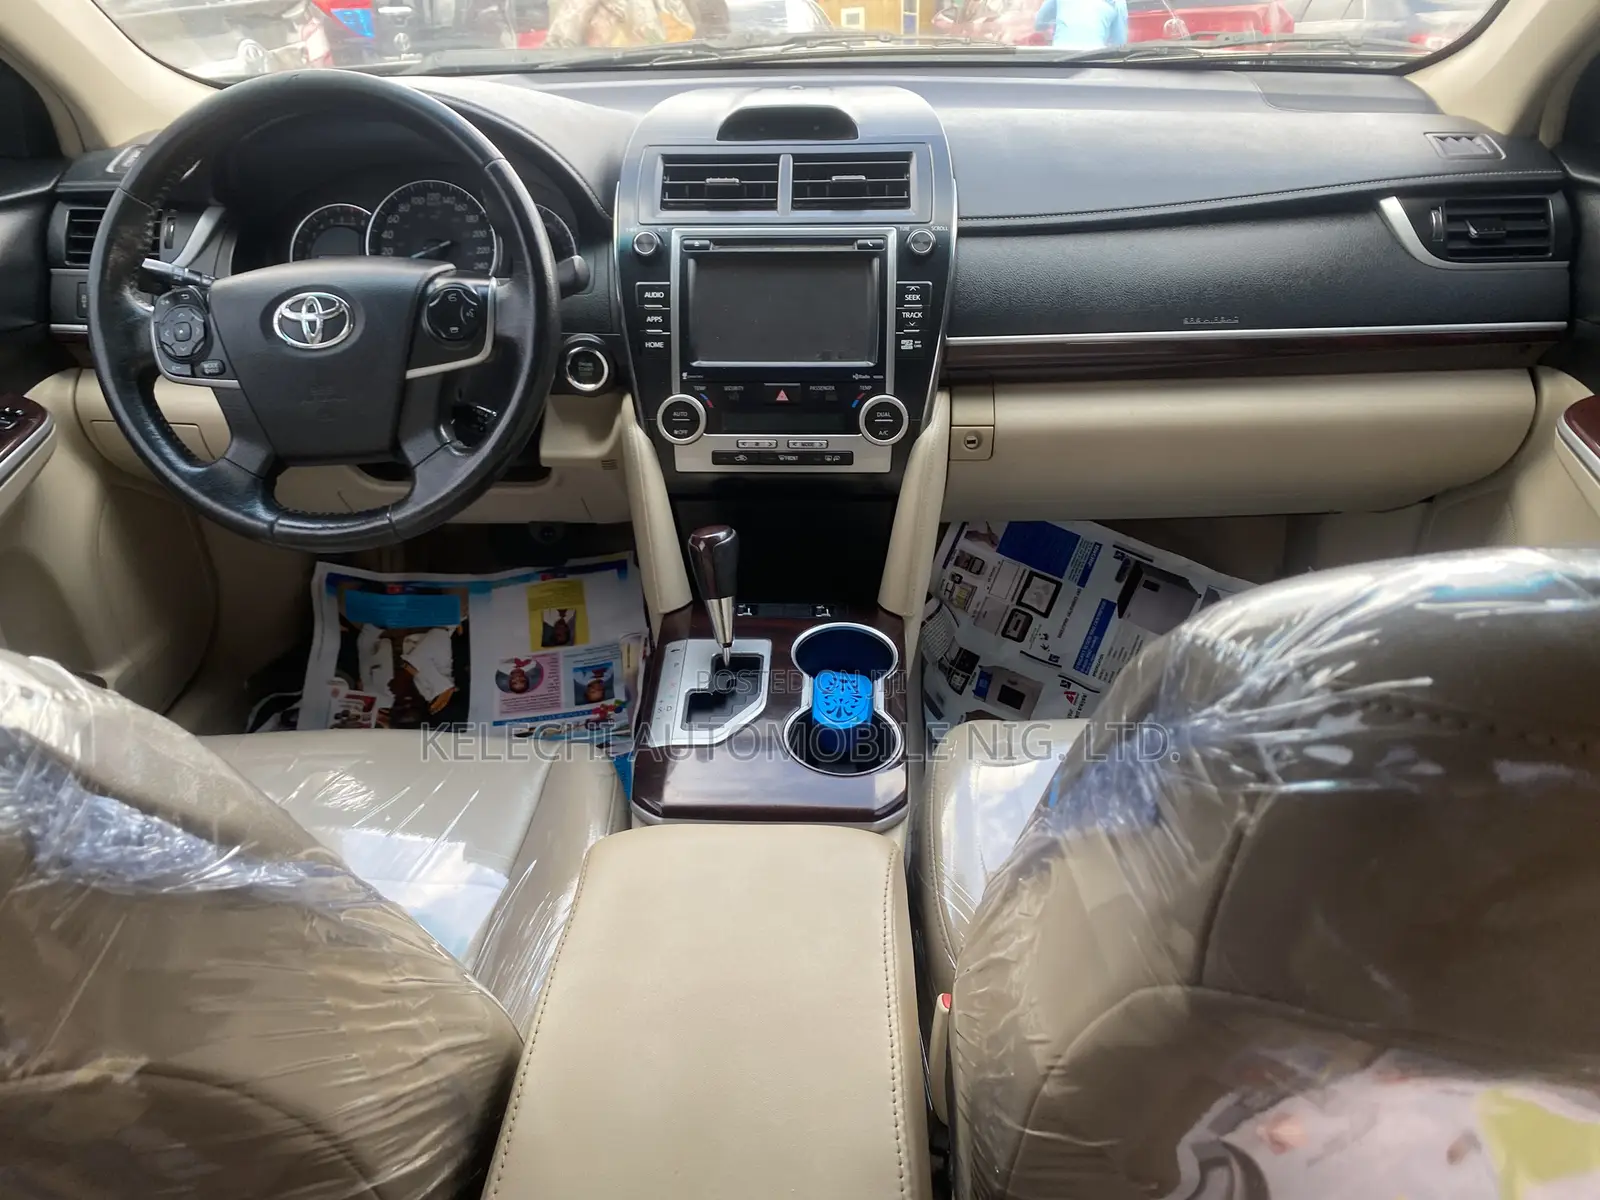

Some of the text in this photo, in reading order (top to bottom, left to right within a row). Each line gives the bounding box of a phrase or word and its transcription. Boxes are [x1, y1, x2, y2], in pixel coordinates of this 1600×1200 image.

[387, 215, 400, 223] 60
[381, 230, 394, 239] 40
[644, 291, 664, 299] AUDIO
[902, 311, 923, 319] TRACK
